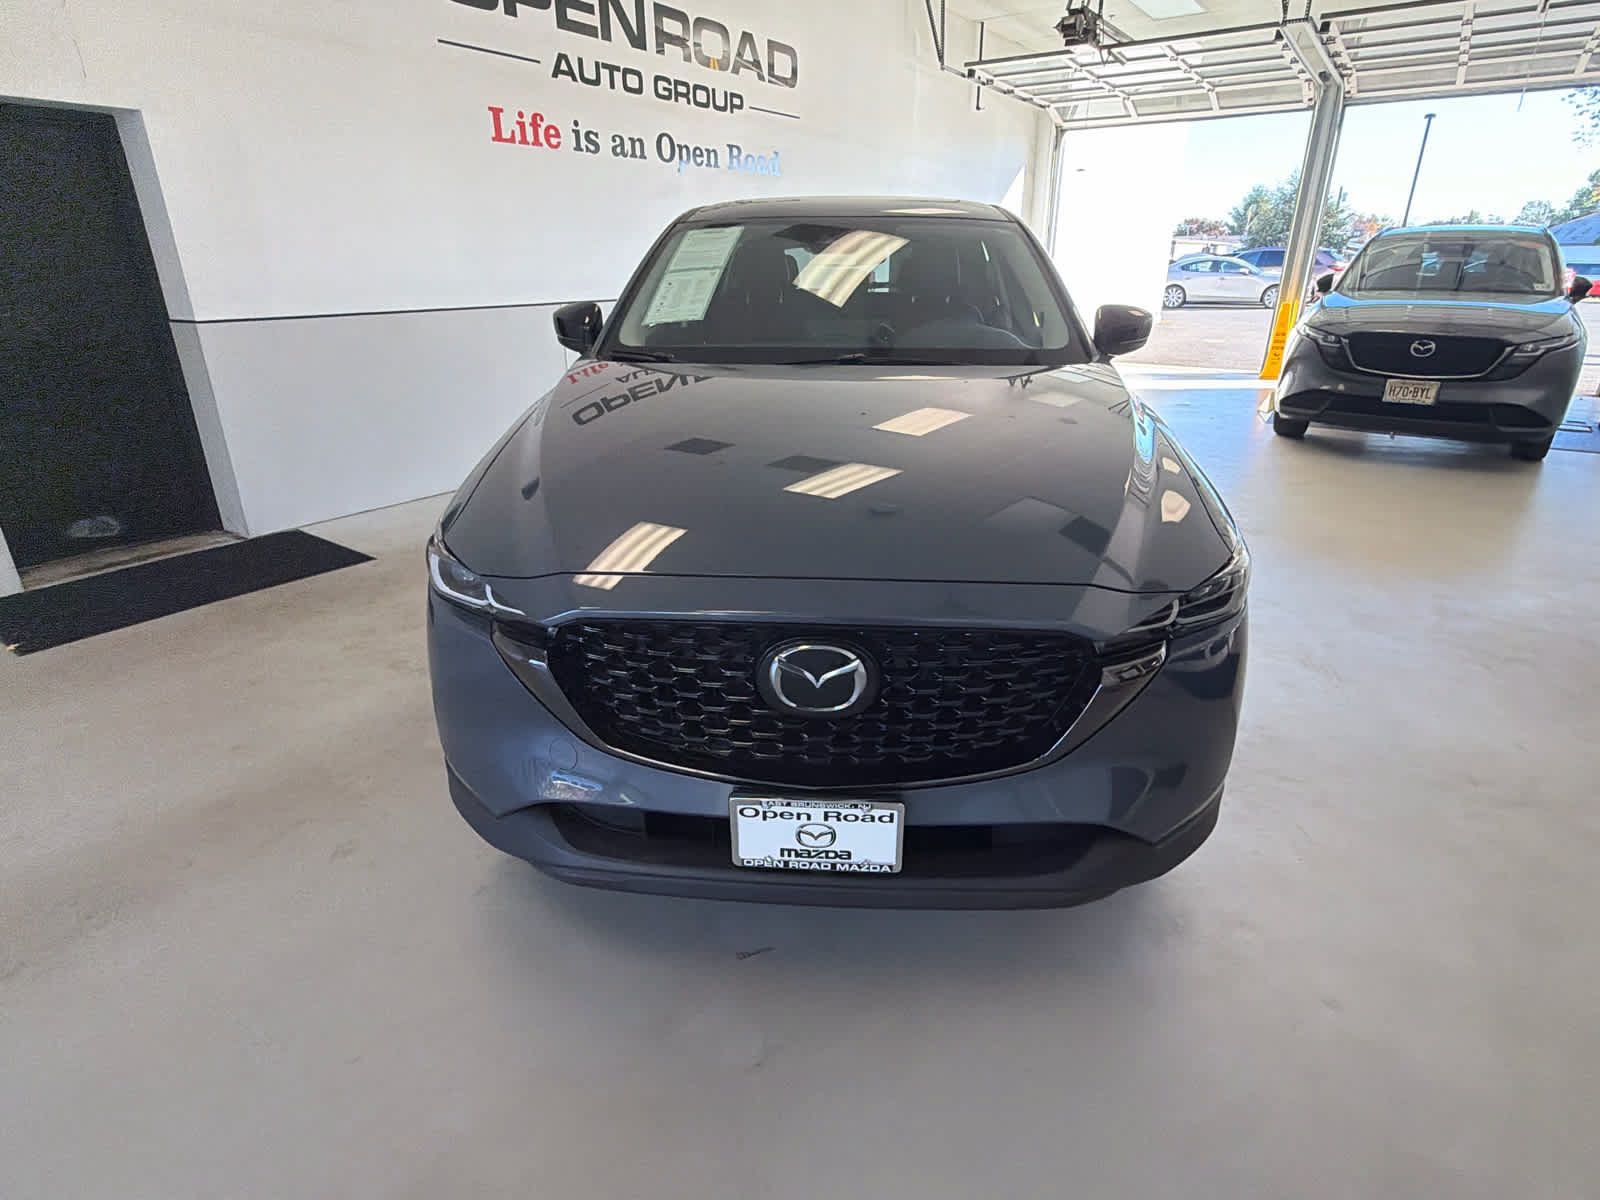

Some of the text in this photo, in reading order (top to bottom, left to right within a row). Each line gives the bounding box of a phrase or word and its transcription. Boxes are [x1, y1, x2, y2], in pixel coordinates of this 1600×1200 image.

[551, 52, 744, 114] AUTO GROUP
[487, 106, 782, 177] Life is an Open Road
[739, 806, 895, 824] Open Road
[779, 847, 852, 861] mazda
[743, 858, 892, 873] OPEN ROAD MAZDA
